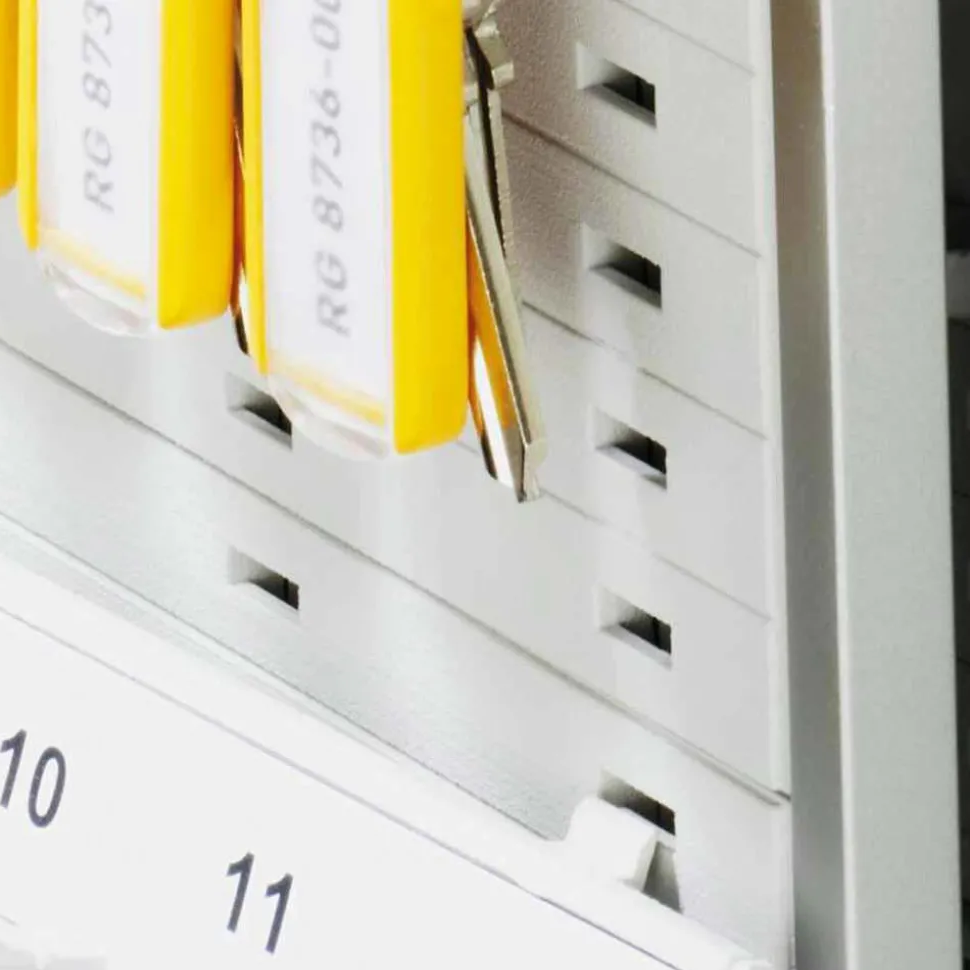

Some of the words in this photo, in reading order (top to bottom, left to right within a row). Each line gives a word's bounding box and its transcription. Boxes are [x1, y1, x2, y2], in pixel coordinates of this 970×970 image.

[83, 127, 115, 214] RG
[316, 250, 351, 337] RG
[226, 851, 293, 955] 11
